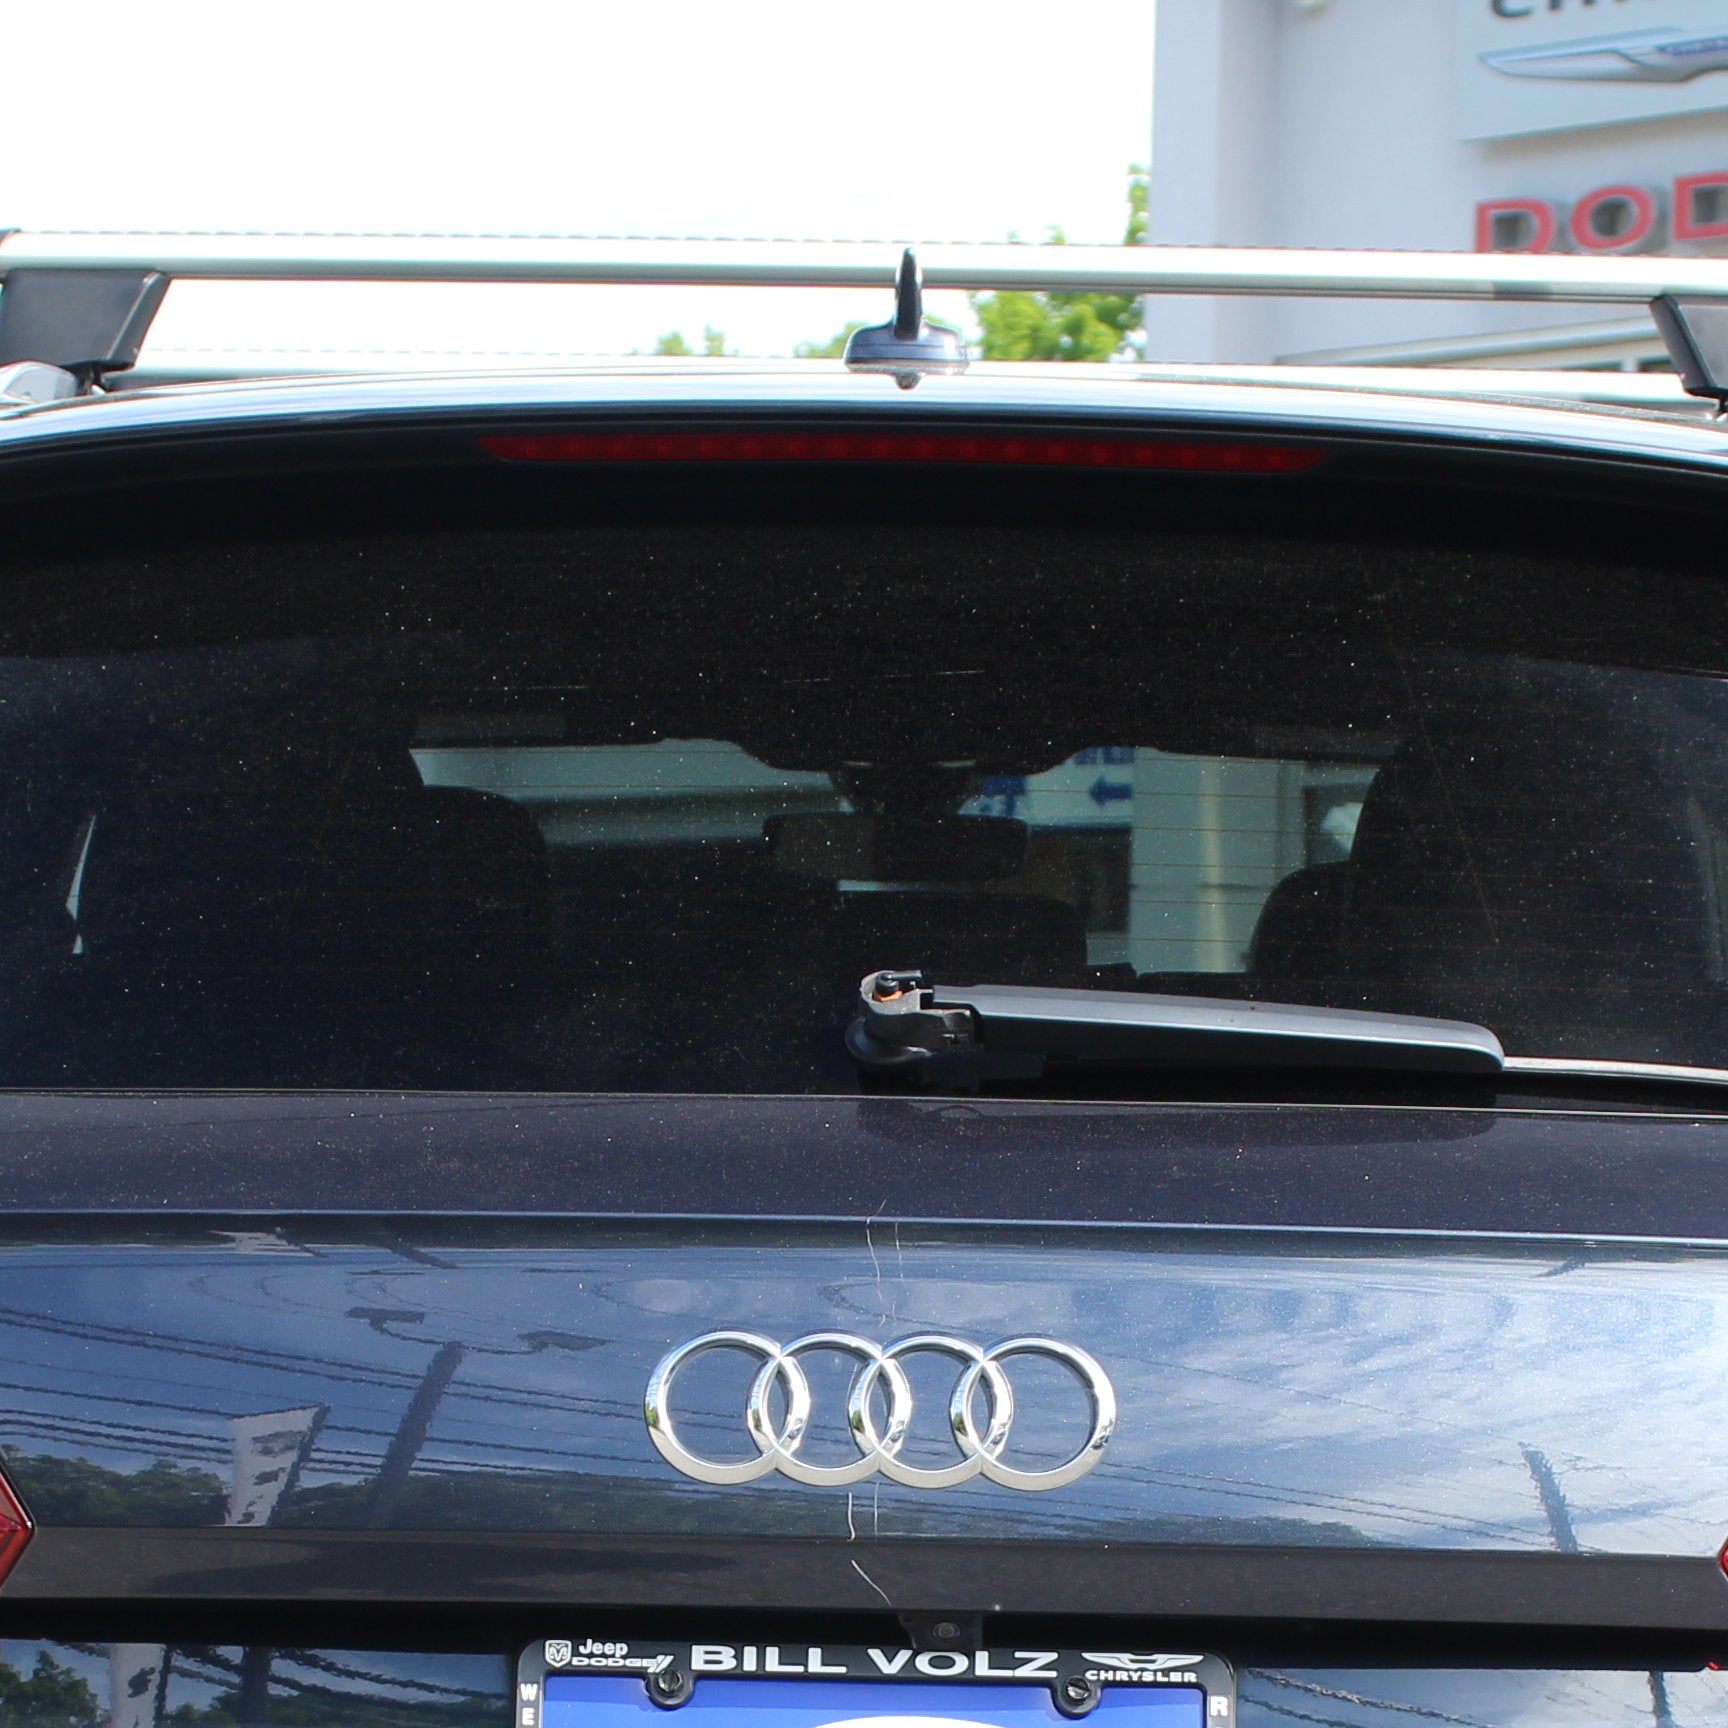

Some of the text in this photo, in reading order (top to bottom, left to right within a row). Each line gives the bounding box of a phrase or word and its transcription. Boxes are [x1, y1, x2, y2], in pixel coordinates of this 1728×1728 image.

[579, 1638, 629, 1656] Jeep
[571, 1656, 660, 1668] DODGE
[691, 1645, 1059, 1678] BILL VOLZ
[1085, 1670, 1199, 1684] CHRYSLER
